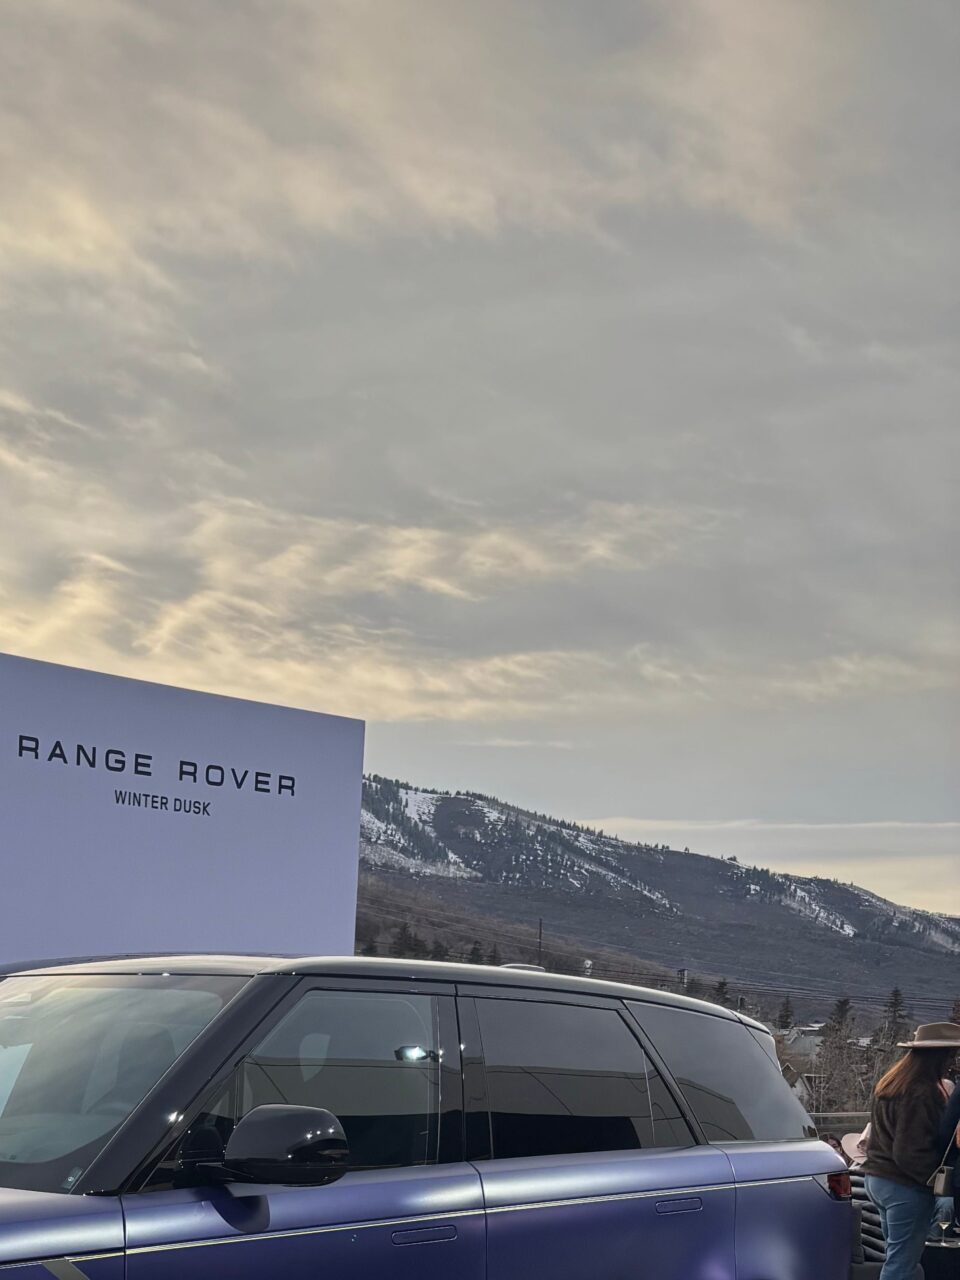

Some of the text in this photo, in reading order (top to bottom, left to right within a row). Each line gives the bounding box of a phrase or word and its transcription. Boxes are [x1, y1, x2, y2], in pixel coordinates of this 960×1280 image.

[18, 735, 296, 796] RANGE ROVER
[114, 790, 211, 816] WINTER DUSK
